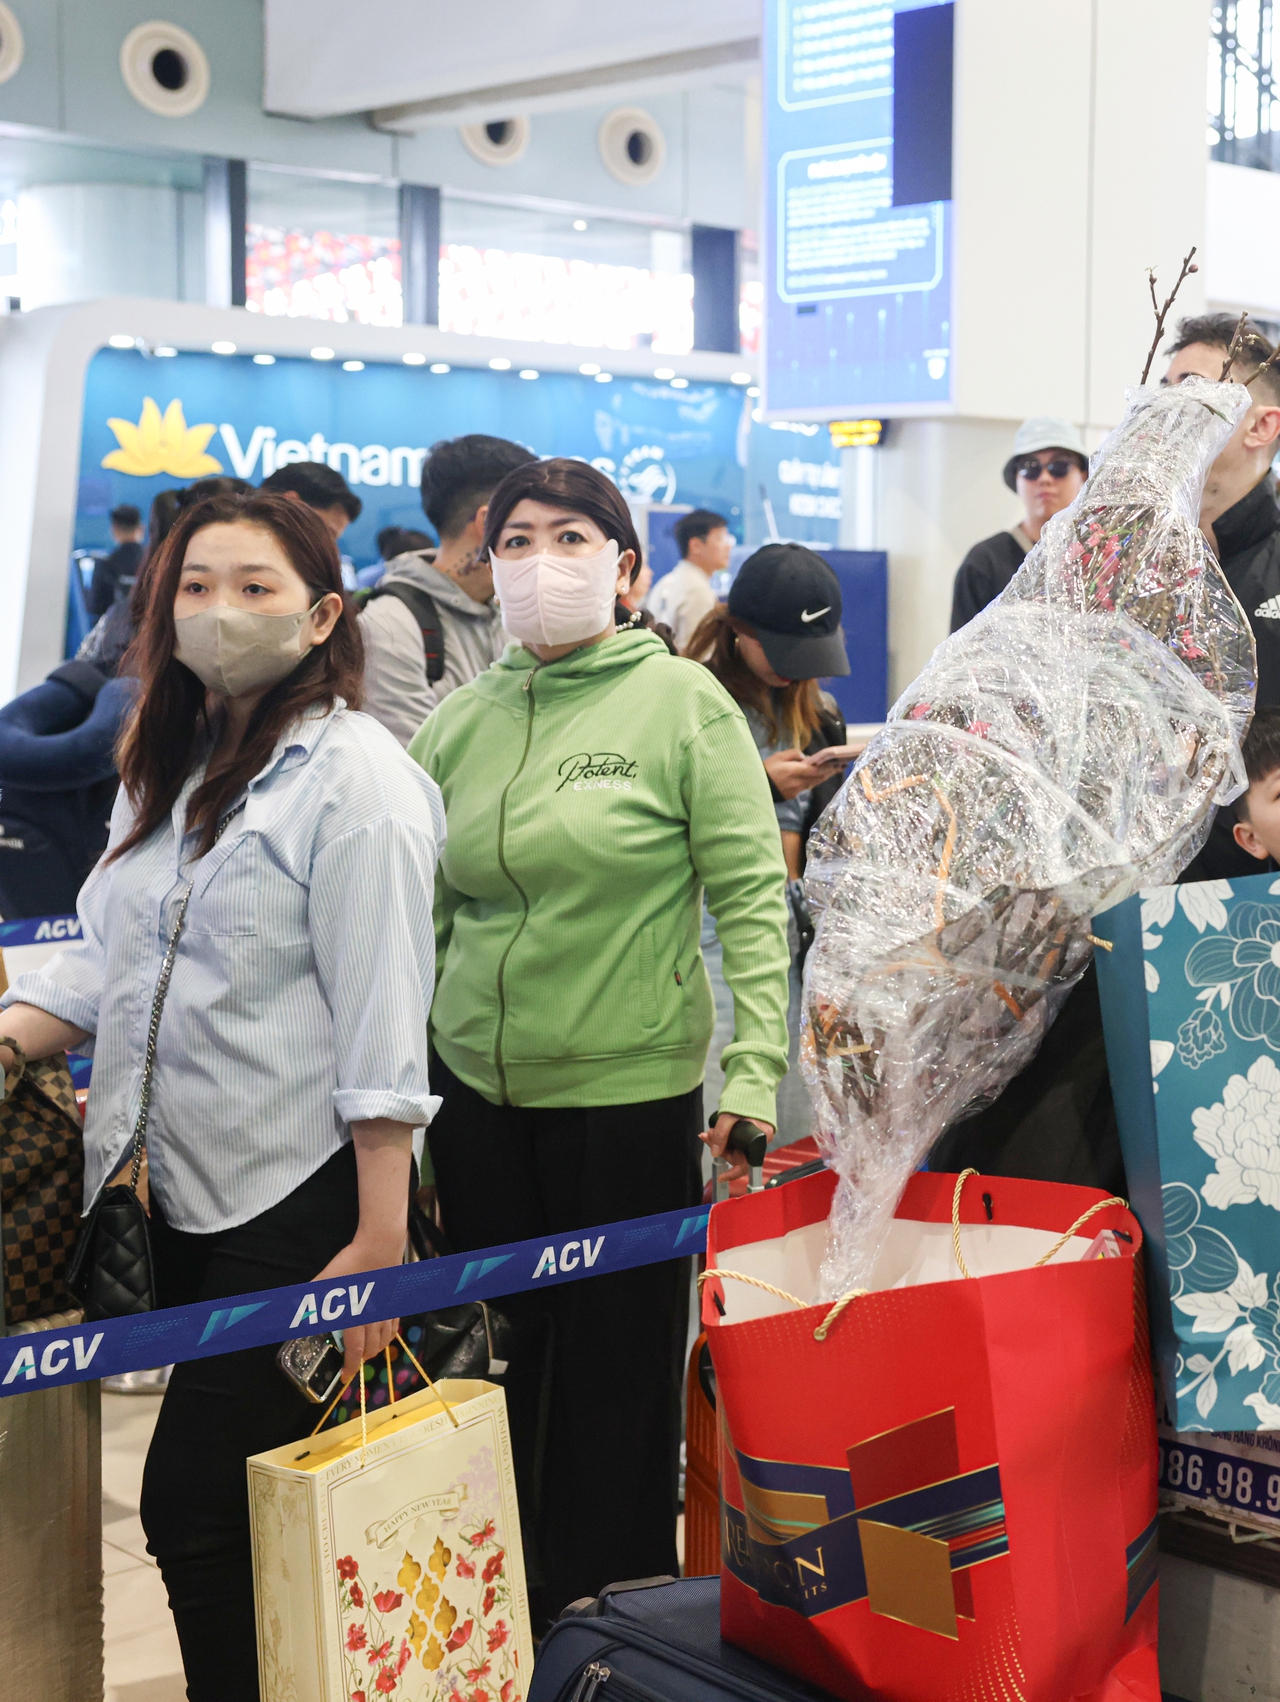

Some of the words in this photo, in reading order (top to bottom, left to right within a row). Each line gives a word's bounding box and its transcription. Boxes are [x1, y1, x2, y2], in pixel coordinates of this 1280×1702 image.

[219, 423, 428, 488] Vietnam
[573, 779, 632, 791] EXNESS
[34, 918, 81, 940] ACV
[532, 1236, 605, 1279] ACV
[289, 1281, 375, 1329] ACV
[2, 1332, 104, 1385] ACV
[325, 1458, 352, 1480] EVERY
[456, 1396, 503, 1420] EGINNING
[497, 1405, 509, 1461] WISHING
[384, 1509, 409, 1533] HAPPY
[411, 1501, 430, 1513] NEW
[431, 1498, 452, 1507] YEAR
